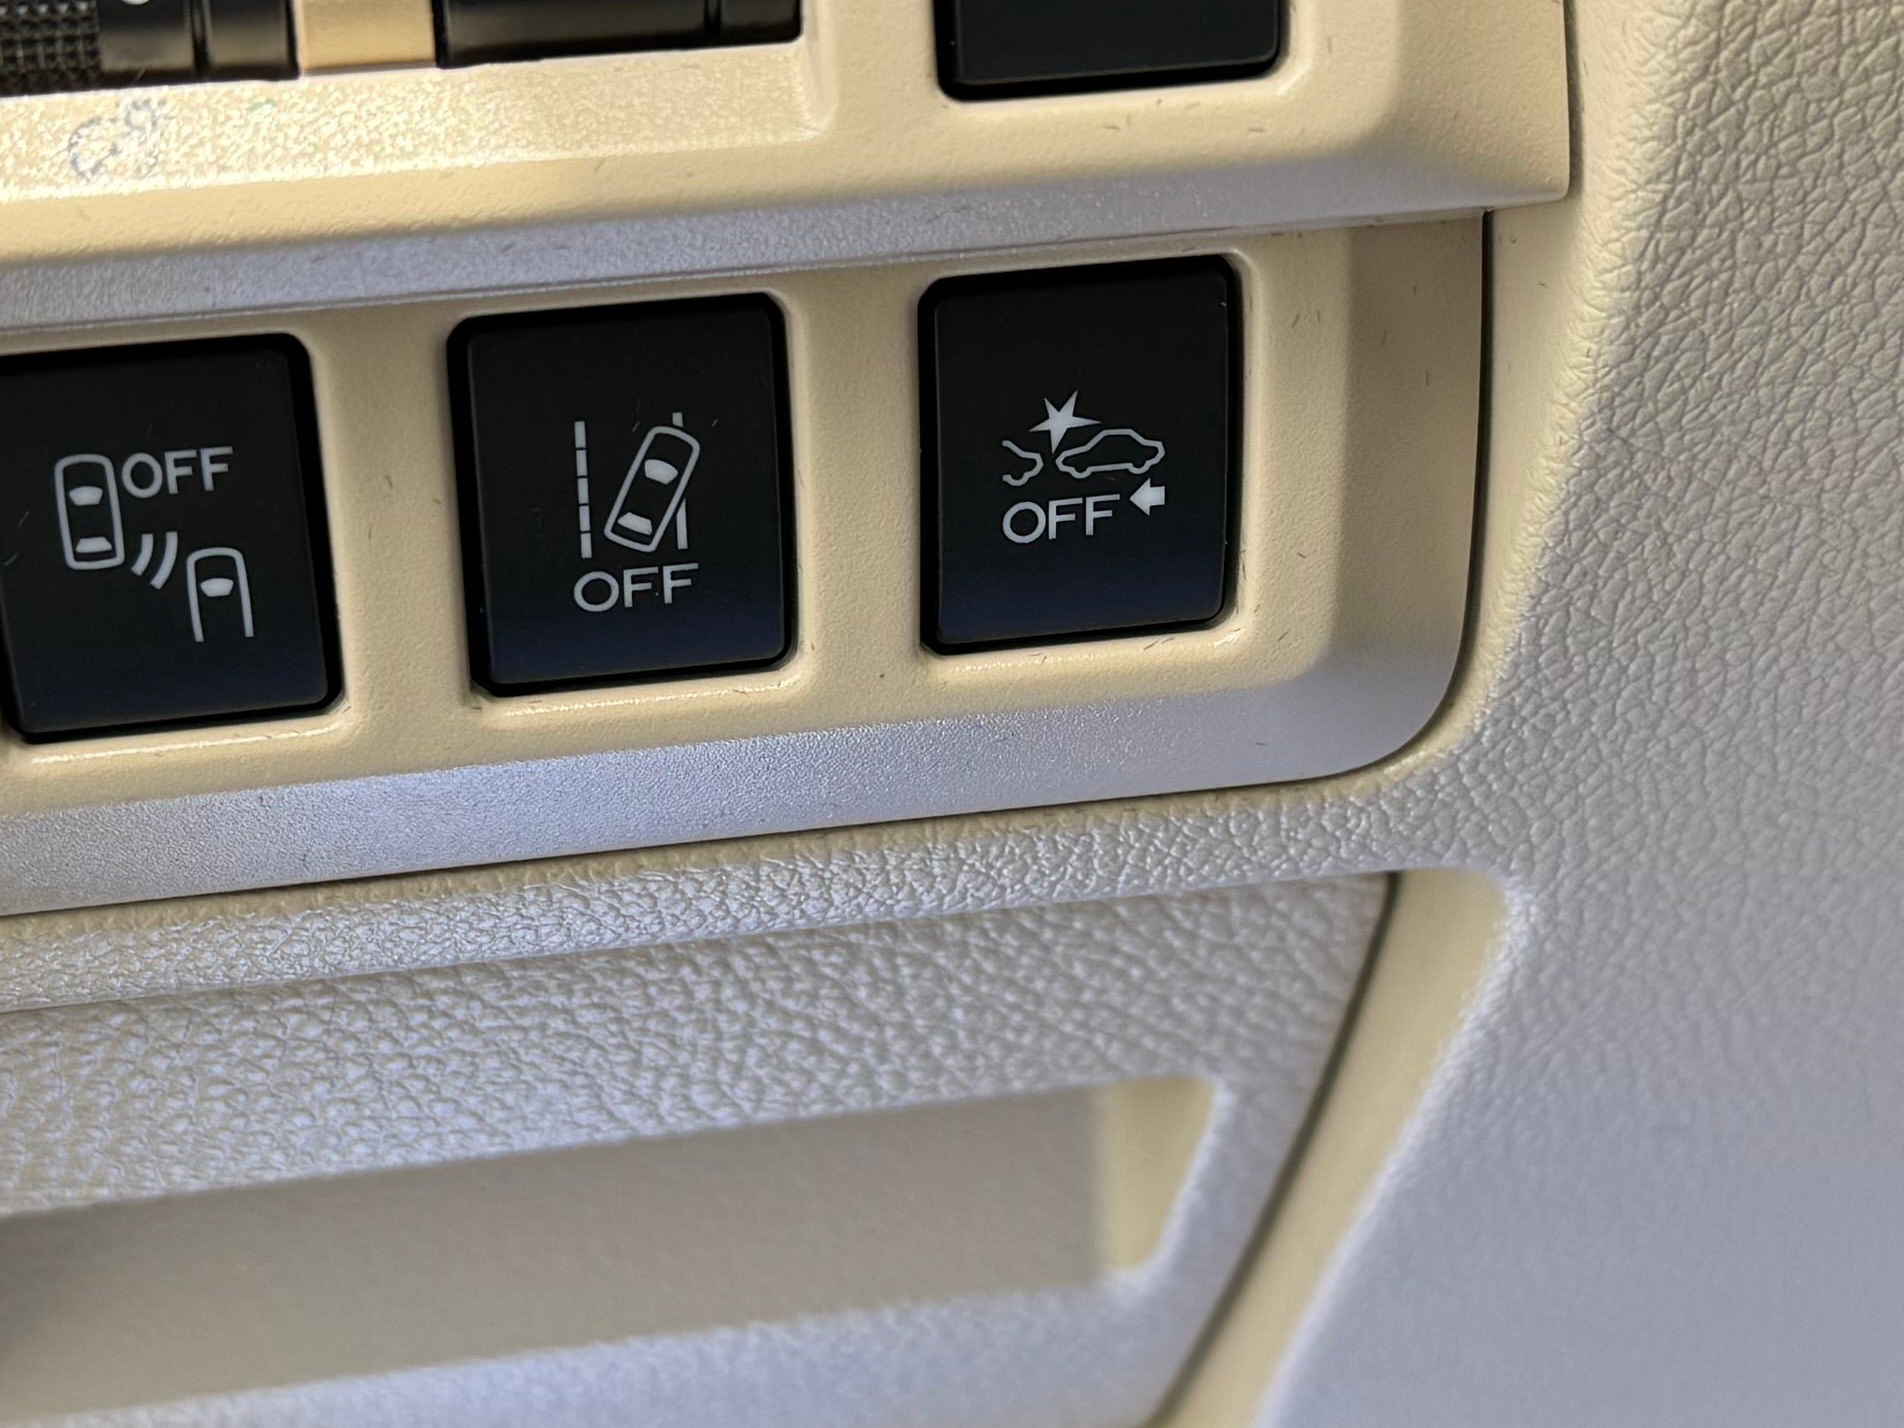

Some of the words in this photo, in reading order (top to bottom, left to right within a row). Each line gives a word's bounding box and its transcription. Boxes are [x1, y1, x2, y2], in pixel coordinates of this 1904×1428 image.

[120, 445, 234, 499] OFF
[1001, 492, 1122, 545] OFF
[572, 562, 700, 613] OFF
